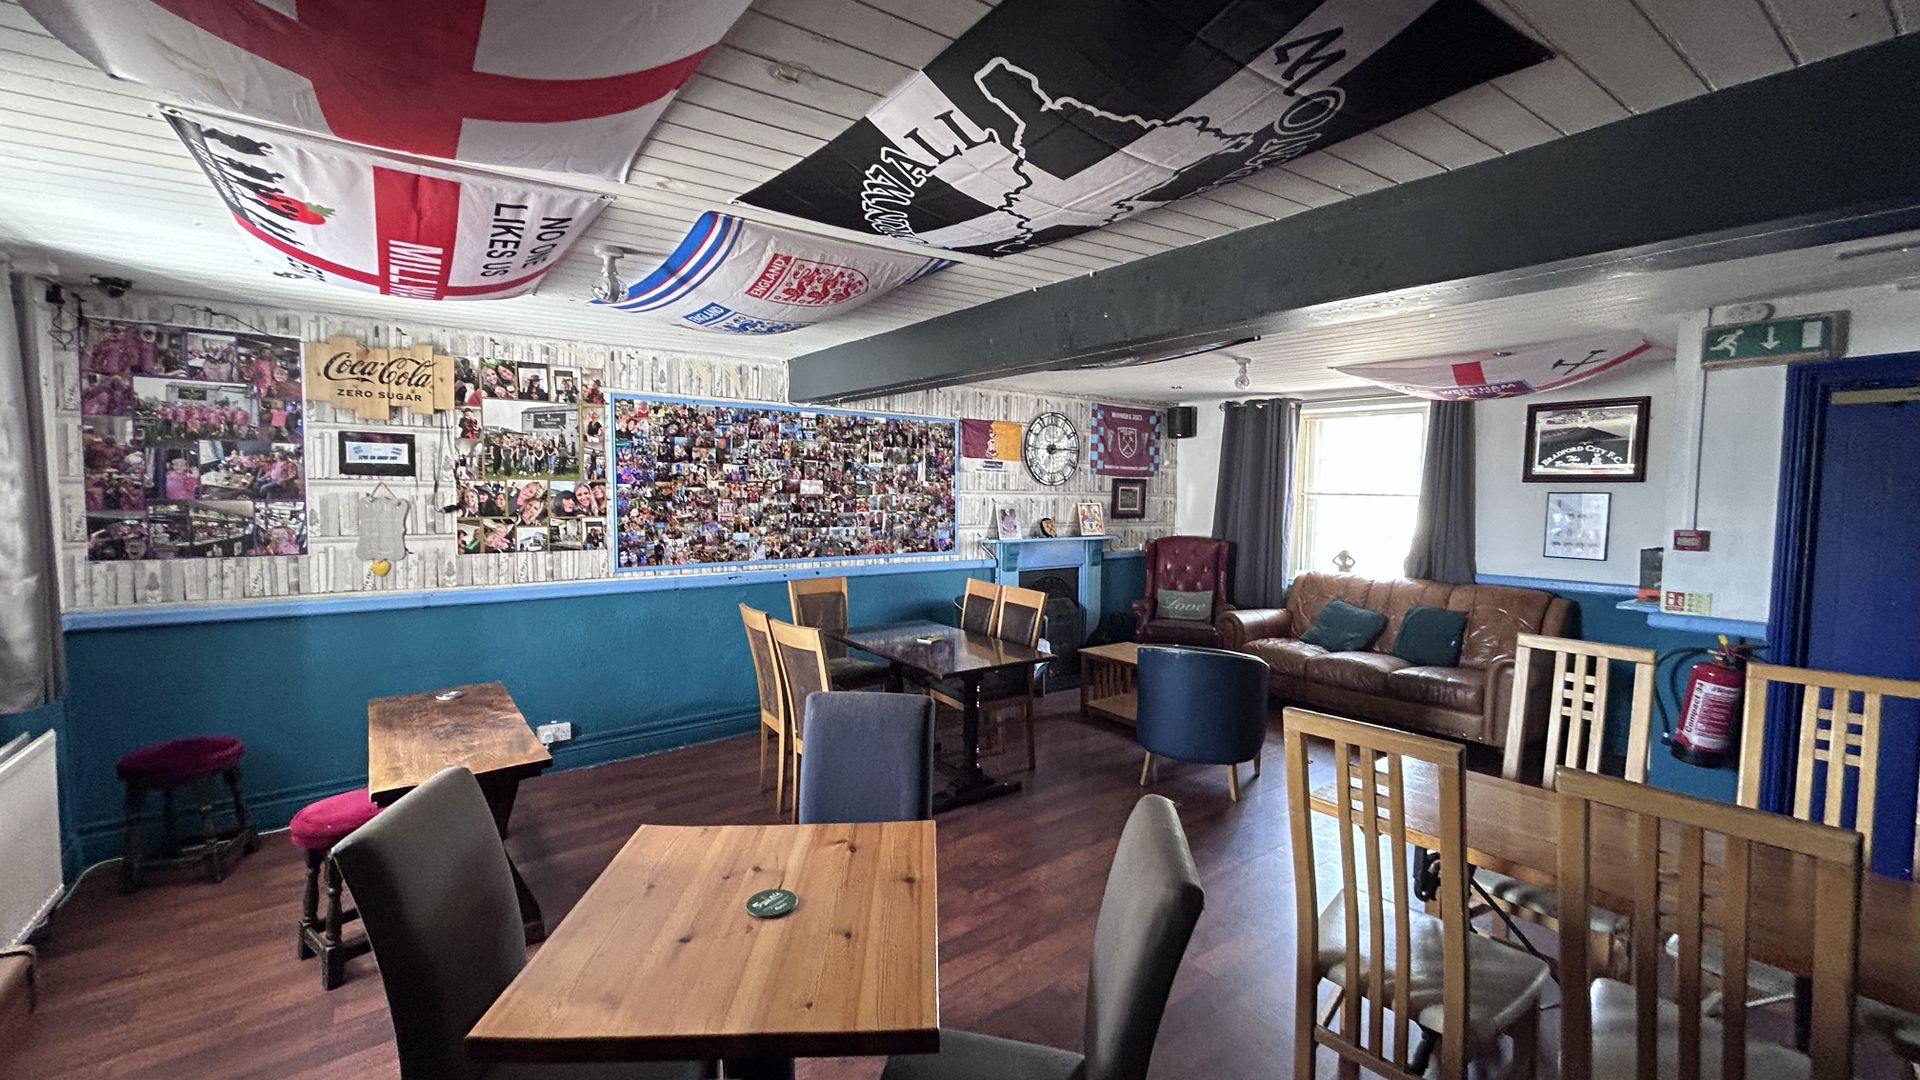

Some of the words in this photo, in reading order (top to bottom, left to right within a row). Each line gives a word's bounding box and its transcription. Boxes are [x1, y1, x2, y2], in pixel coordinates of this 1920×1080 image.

[486, 203, 528, 259] LIKES
[536, 217, 573, 241] NO
[522, 243, 558, 269] ONE
[480, 261, 514, 277] US
[750, 258, 786, 297] ENGLAND
[689, 306, 725, 324] ENGLAND
[323, 351, 437, 388] Coca-Cola
[337, 388, 373, 398] ZERO
[378, 391, 423, 402] SUGAR
[1440, 386, 1480, 396] WEST
[1480, 383, 1517, 395] HAM
[1541, 446, 1585, 467] BRADFORD
[1161, 594, 1207, 611] Love
[1685, 693, 1701, 733] Compact
